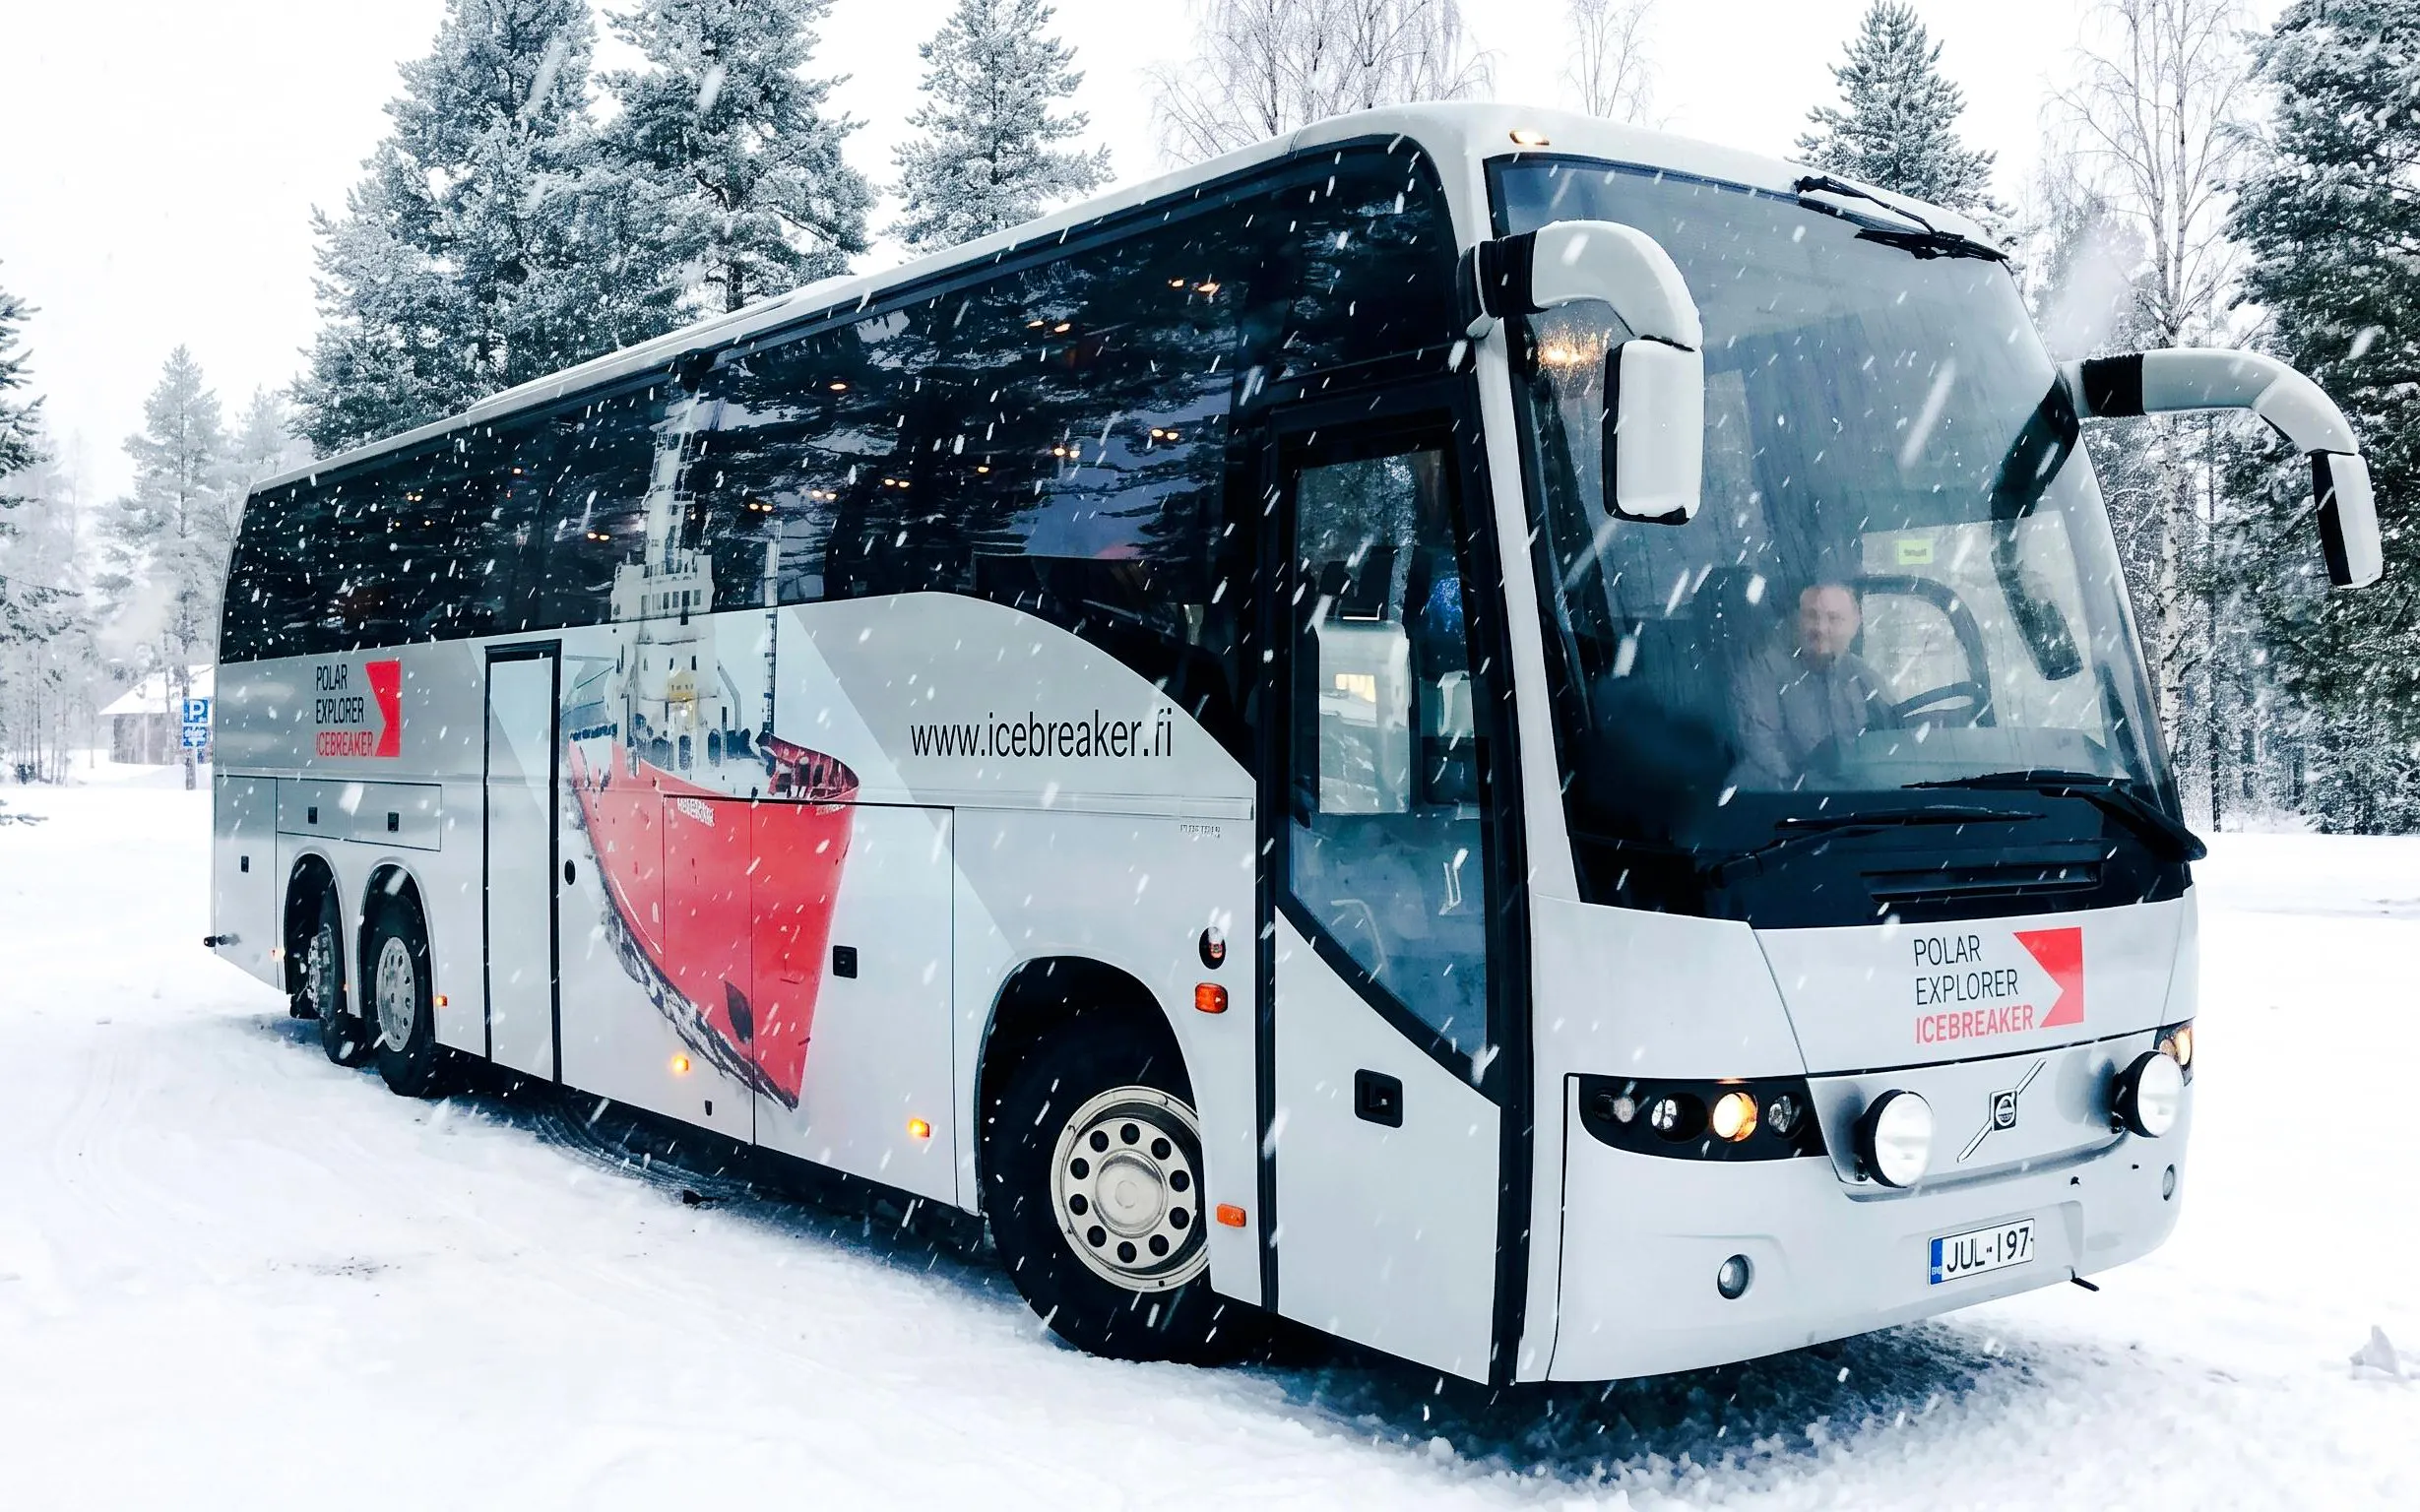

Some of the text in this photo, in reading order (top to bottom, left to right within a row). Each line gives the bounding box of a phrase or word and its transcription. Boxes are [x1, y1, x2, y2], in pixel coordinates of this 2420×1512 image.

[316, 663, 348, 691] POLAR
[189, 700, 206, 722] P
[316, 697, 364, 724] EXPLORER
[316, 730, 373, 756] ICEBREAKER
[911, 708, 1173, 757] www.icebreaker.fi
[1913, 934, 1982, 967] POLAR
[1916, 969, 2019, 1005] EXPLORER
[1916, 1004, 2034, 1043] ICEBREAKER
[1946, 1227, 2030, 1273] JUL-197
